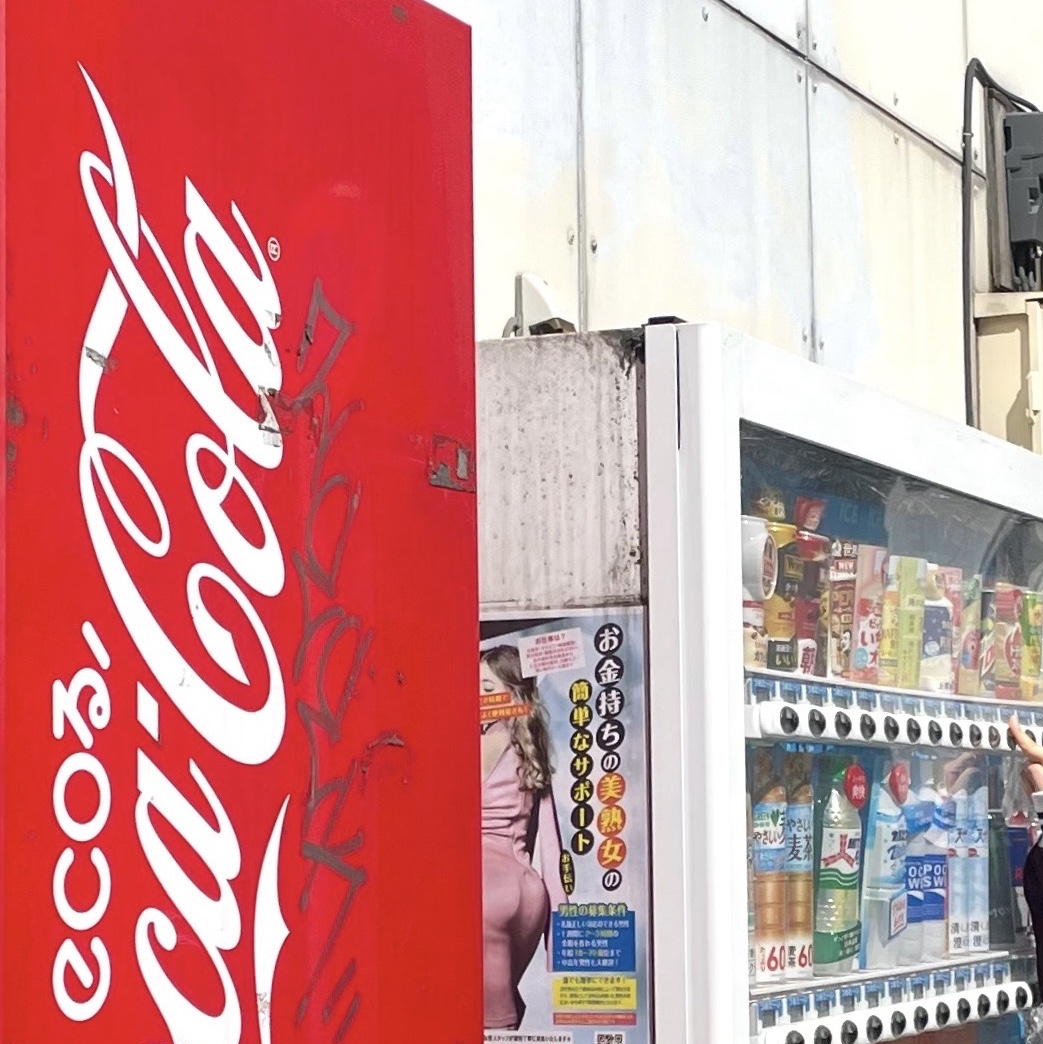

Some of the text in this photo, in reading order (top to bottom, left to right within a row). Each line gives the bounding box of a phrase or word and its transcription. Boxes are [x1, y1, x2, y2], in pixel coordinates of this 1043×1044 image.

[570, 681, 591, 853] 簡単なサポート
[598, 626, 625, 889] お金持ちの美熟女の
